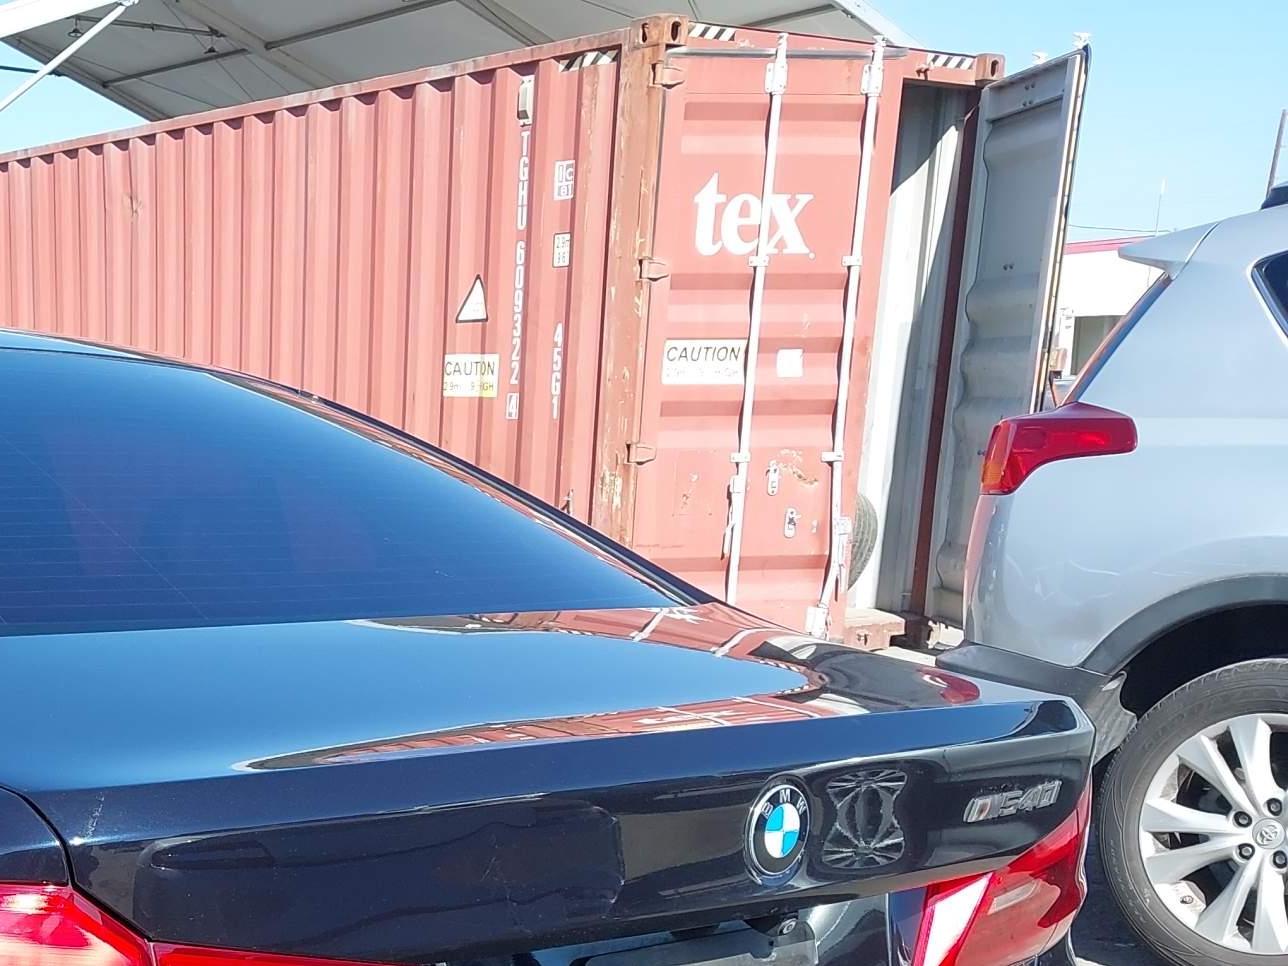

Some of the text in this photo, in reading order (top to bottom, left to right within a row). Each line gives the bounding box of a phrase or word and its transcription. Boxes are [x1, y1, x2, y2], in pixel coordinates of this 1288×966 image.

[516, 131, 531, 231] TGHU
[694, 172, 815, 256] tex
[509, 241, 525, 385] 609322
[666, 346, 741, 362] CAUTION
[551, 323, 563, 420] 45G1
[761, 788, 806, 820] BMW
